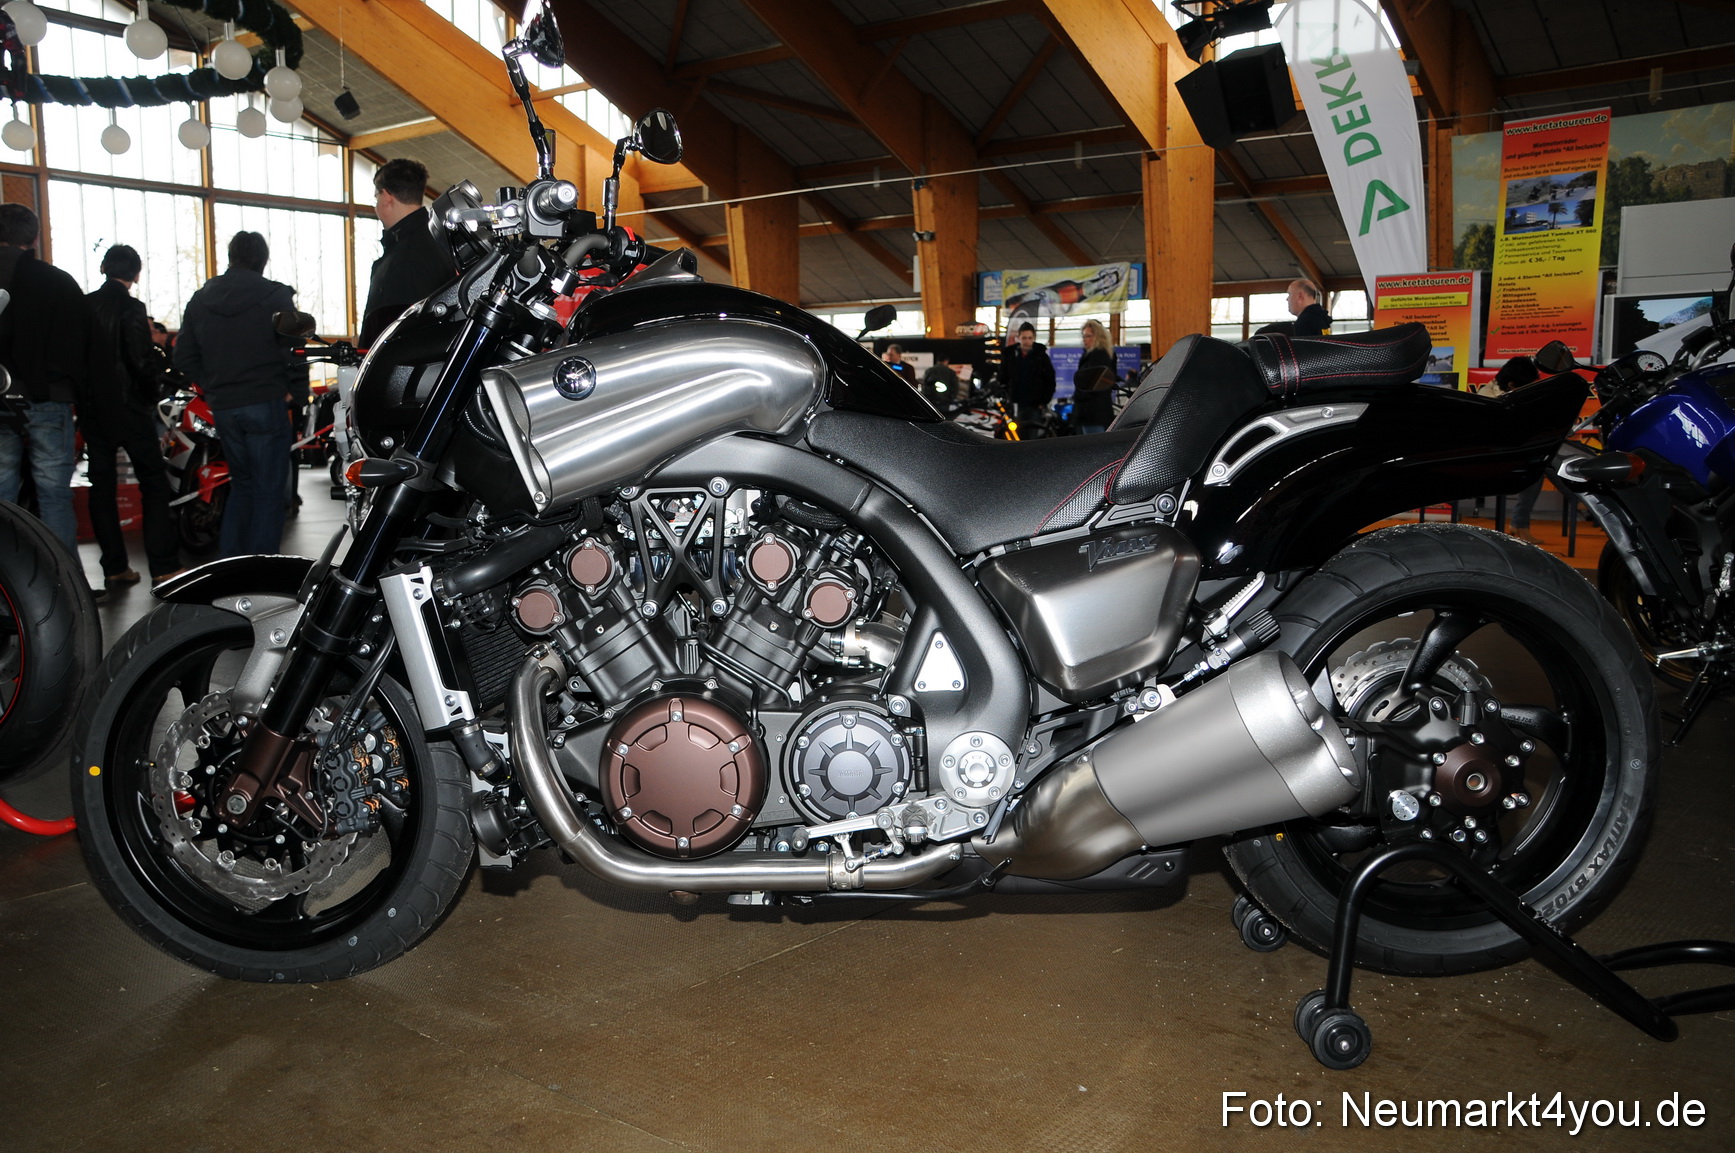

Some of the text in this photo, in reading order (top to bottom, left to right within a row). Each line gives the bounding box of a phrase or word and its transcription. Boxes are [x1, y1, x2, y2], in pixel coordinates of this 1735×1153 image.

[1296, 21, 1383, 167] DEKRA
[1505, 114, 1607, 136] www.kretatouren.de
[1505, 152, 1517, 160] und
[1518, 150, 1541, 160] günstige
[1378, 276, 1470, 289] www.kretatouren.de
[837, 769, 864, 778] YAMAHA
[1587, 791, 1636, 877] BATTLAX
